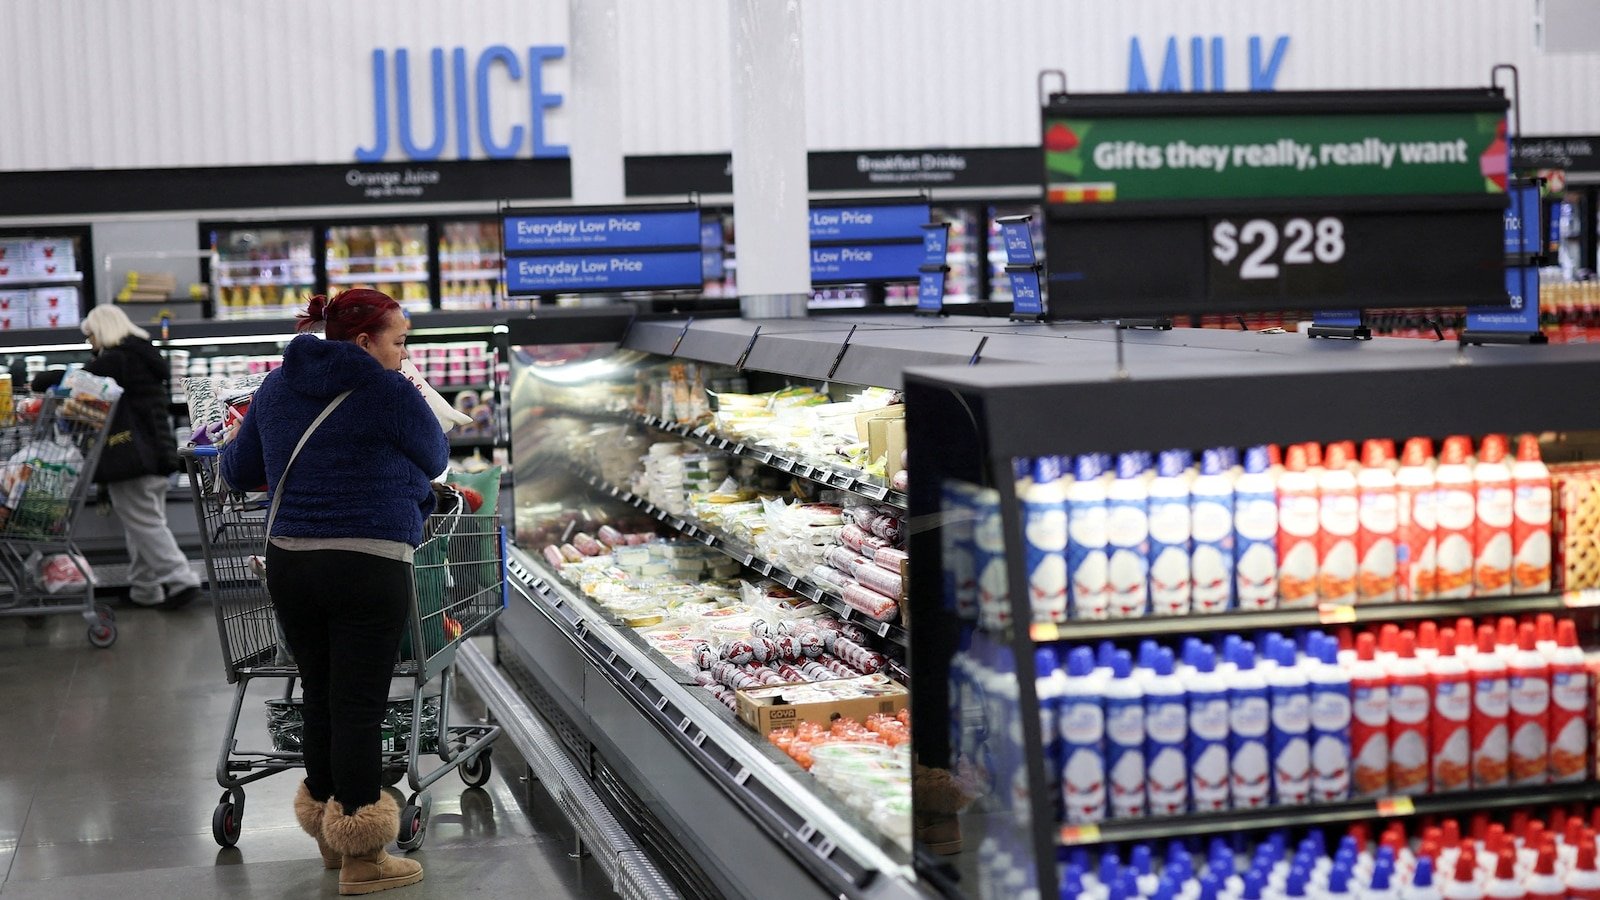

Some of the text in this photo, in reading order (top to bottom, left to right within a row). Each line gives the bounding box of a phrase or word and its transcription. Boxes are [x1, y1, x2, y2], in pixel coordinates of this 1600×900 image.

[355, 46, 569, 162] JUICE
[857, 153, 967, 172] Breakfast Drinks
[1093, 137, 1468, 172] Gifts they really, really want
[345, 168, 440, 187] Orange Juice
[517, 217, 641, 236] Everyday Low Price
[813, 211, 873, 225] Low Price
[813, 248, 873, 263] Low Price
[519, 259, 642, 276] Everyday Low Price
[770, 709, 795, 719] GOYA
